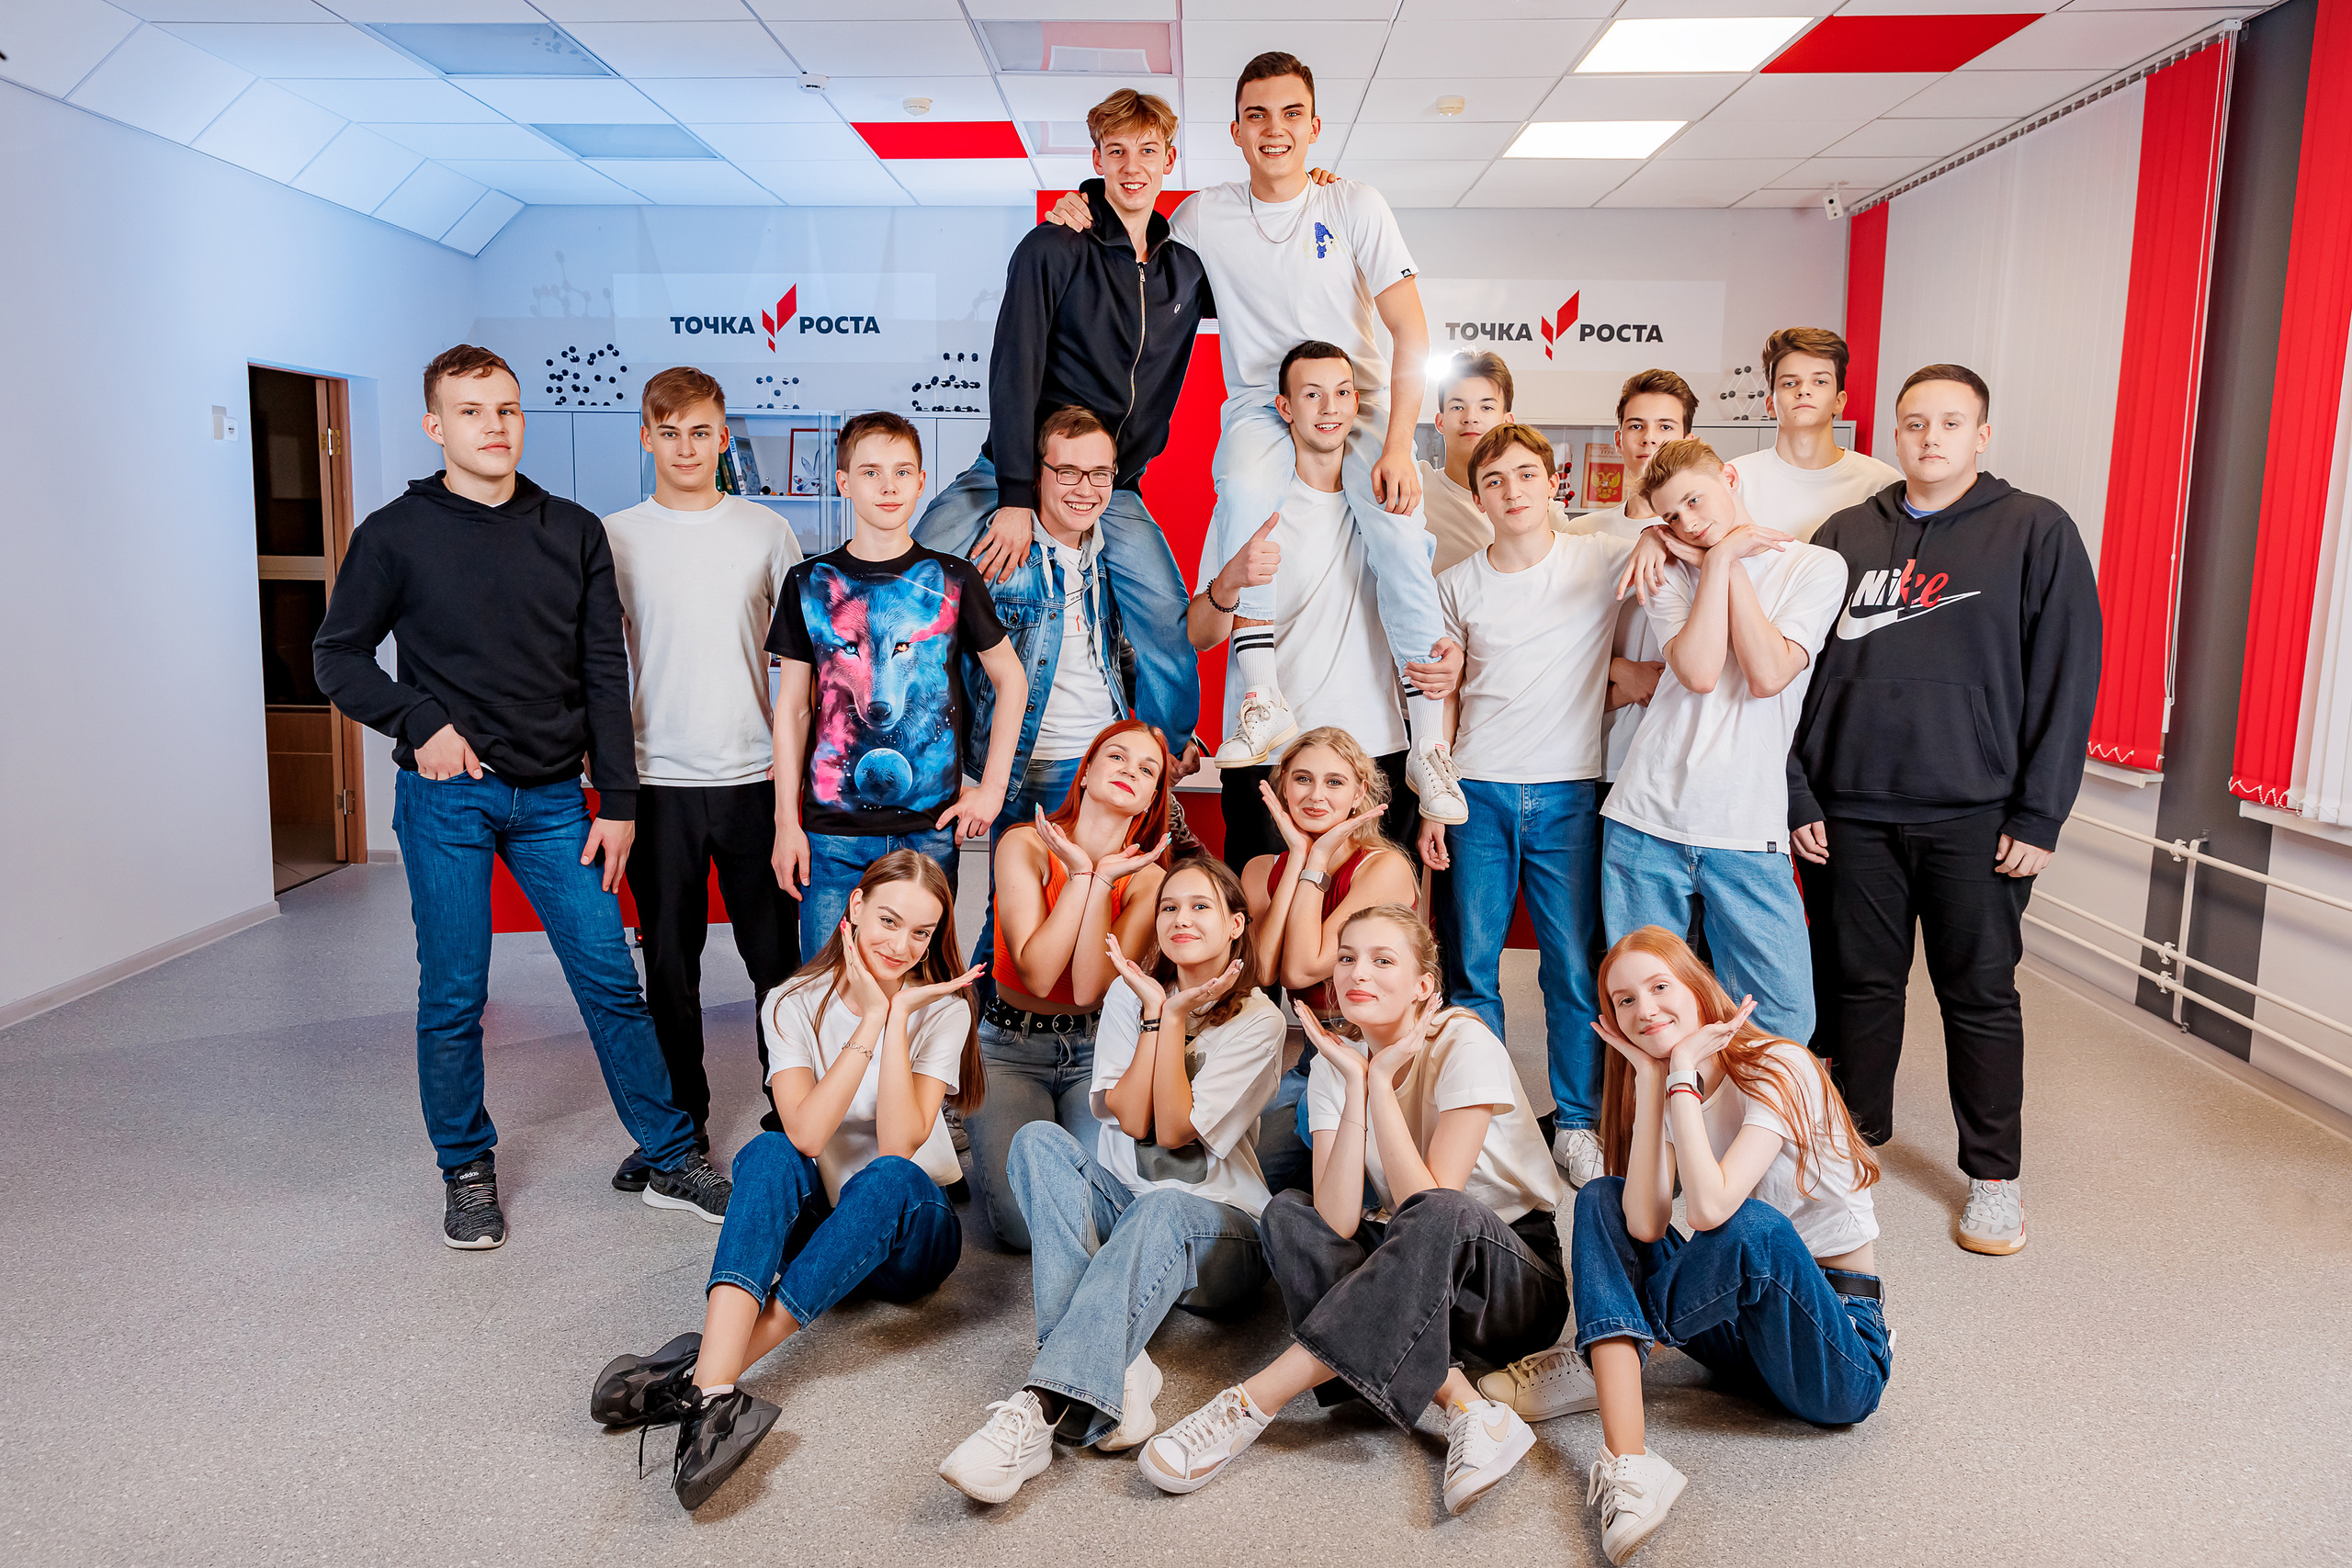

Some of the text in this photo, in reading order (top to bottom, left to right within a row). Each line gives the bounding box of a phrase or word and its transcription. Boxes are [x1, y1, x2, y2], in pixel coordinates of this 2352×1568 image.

[670, 315, 880, 335] ТОЧКА РОСТА
[1445, 322, 1664, 343] ТОЧКА РОСТА
